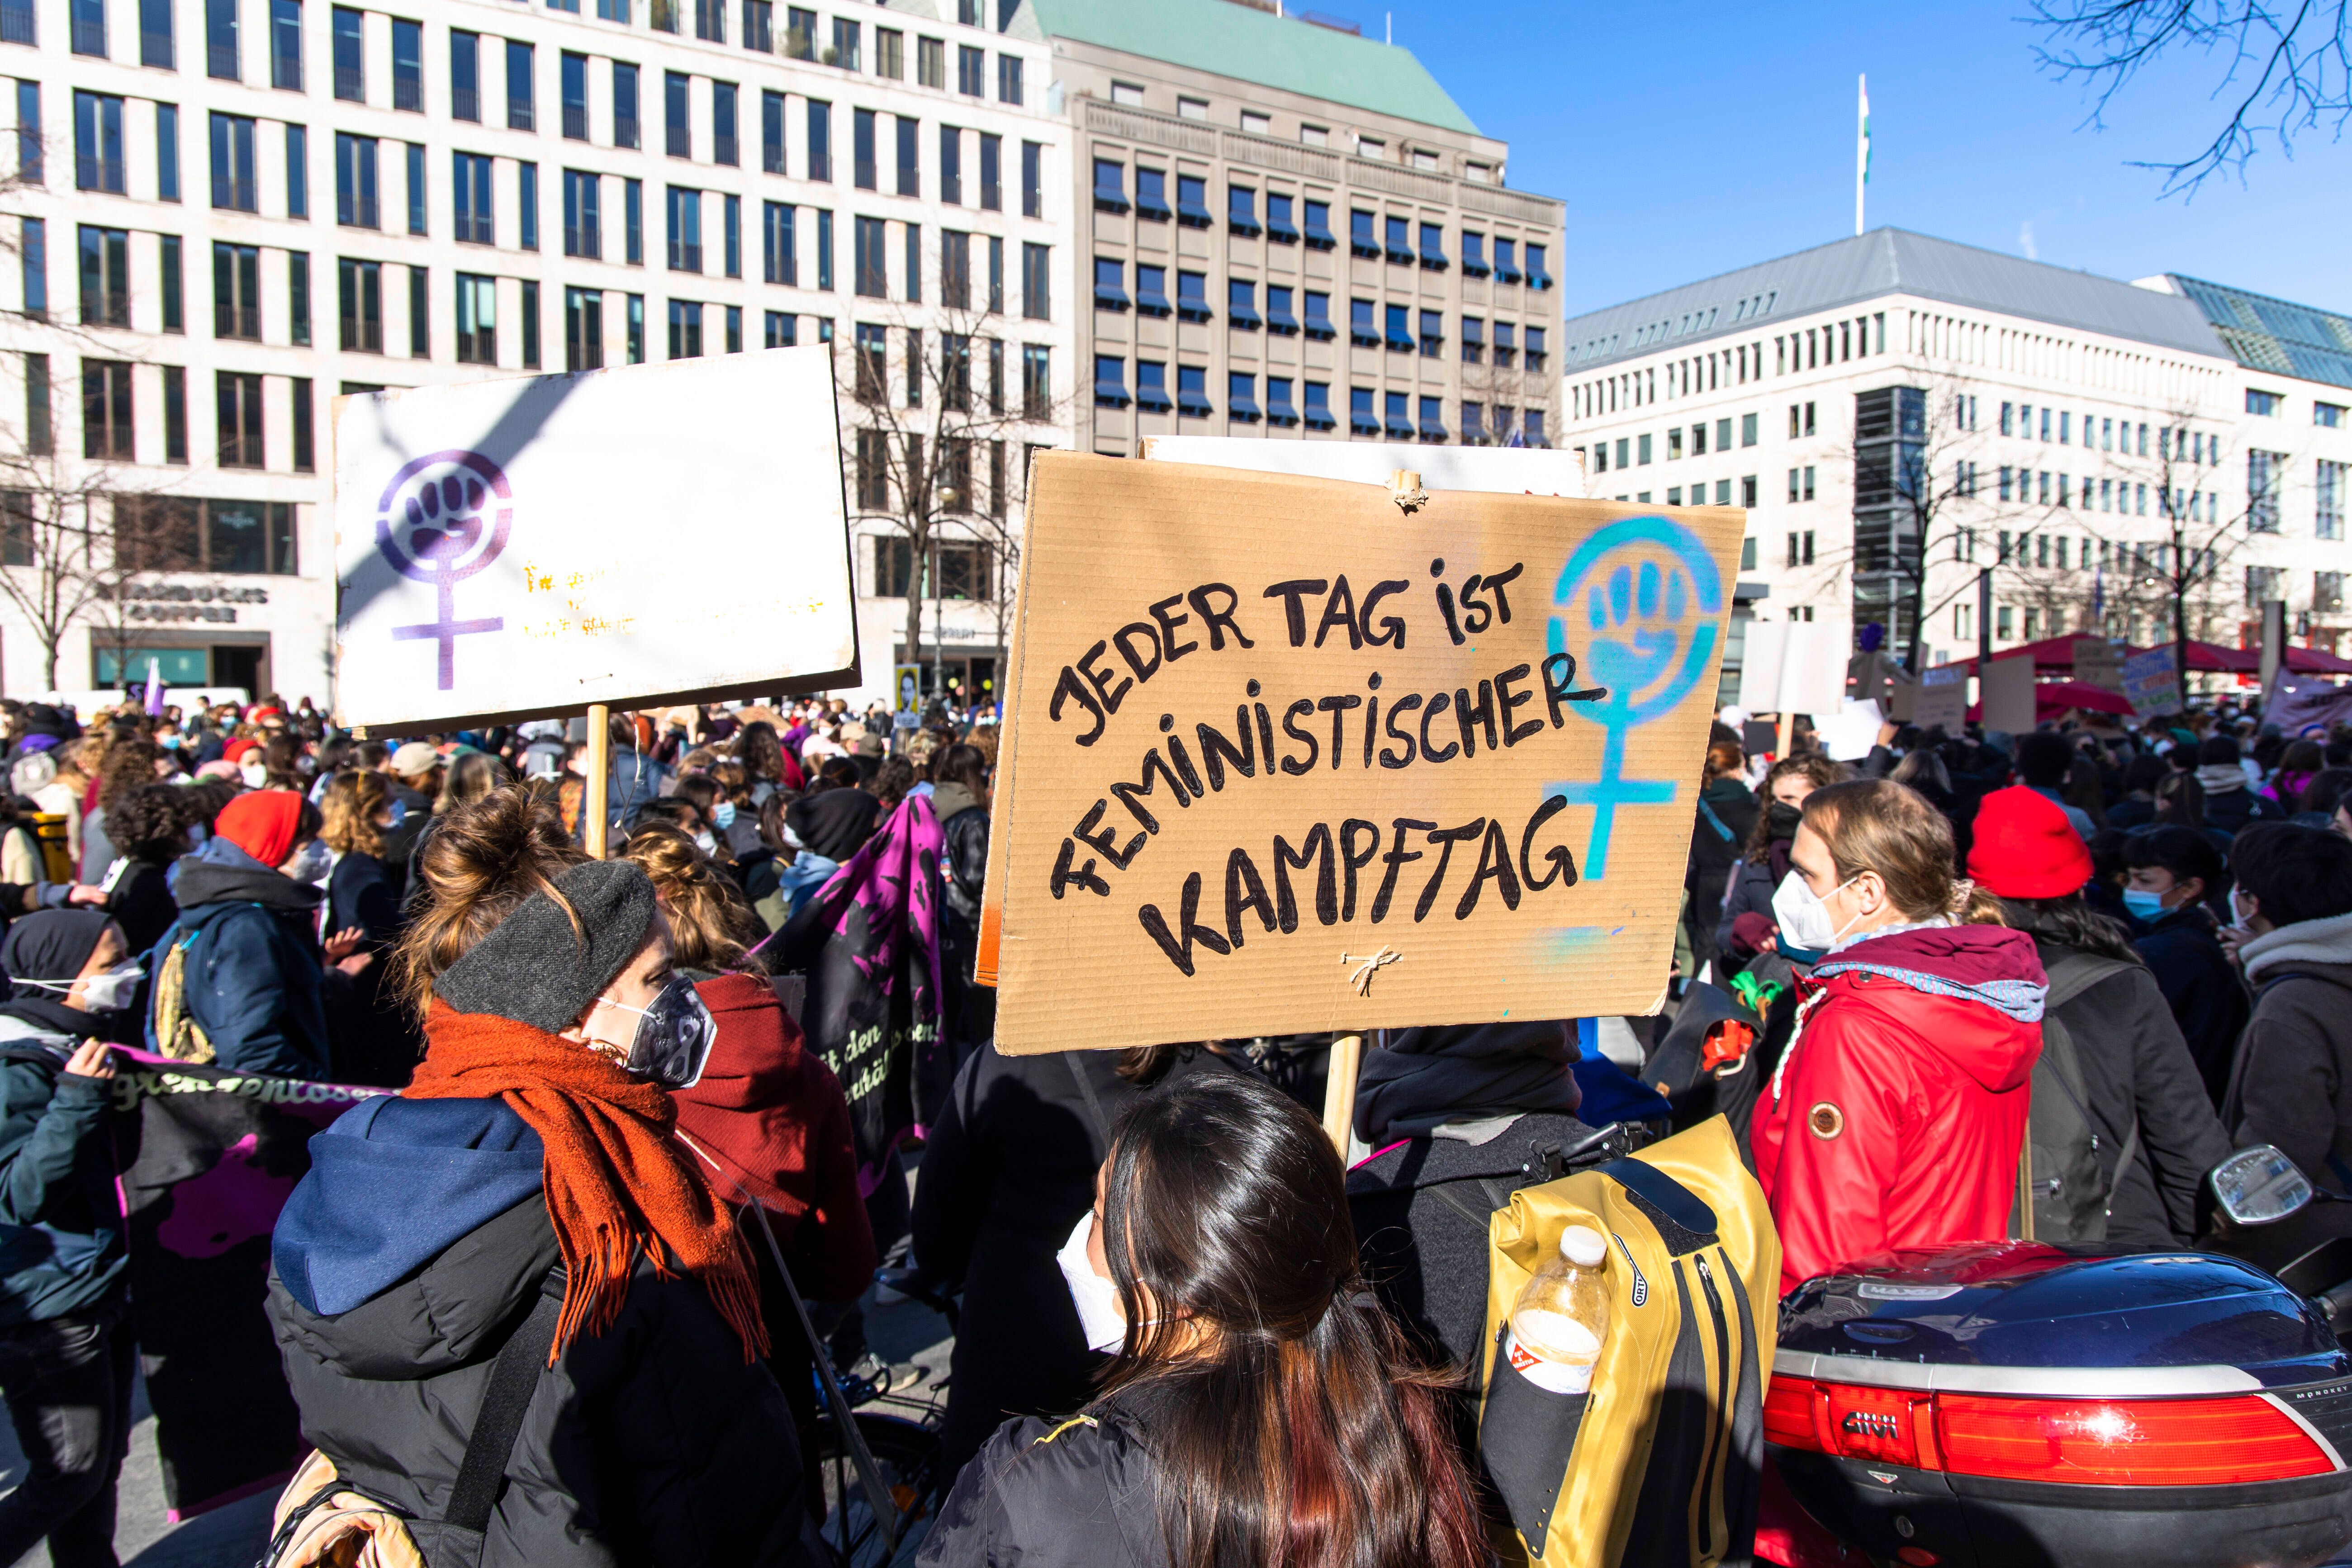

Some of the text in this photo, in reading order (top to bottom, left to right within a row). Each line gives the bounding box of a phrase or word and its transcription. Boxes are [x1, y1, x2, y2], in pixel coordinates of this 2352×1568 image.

[1049, 583, 1254, 747] JEDER
[1263, 574, 1410, 650] TAG
[1138, 795, 1578, 977] KAMPFTAG
[844, 1025, 882, 1062] den
[2296, 1386, 2347, 1399] MONOKEY
[1842, 1411, 1898, 1439] GIVI
